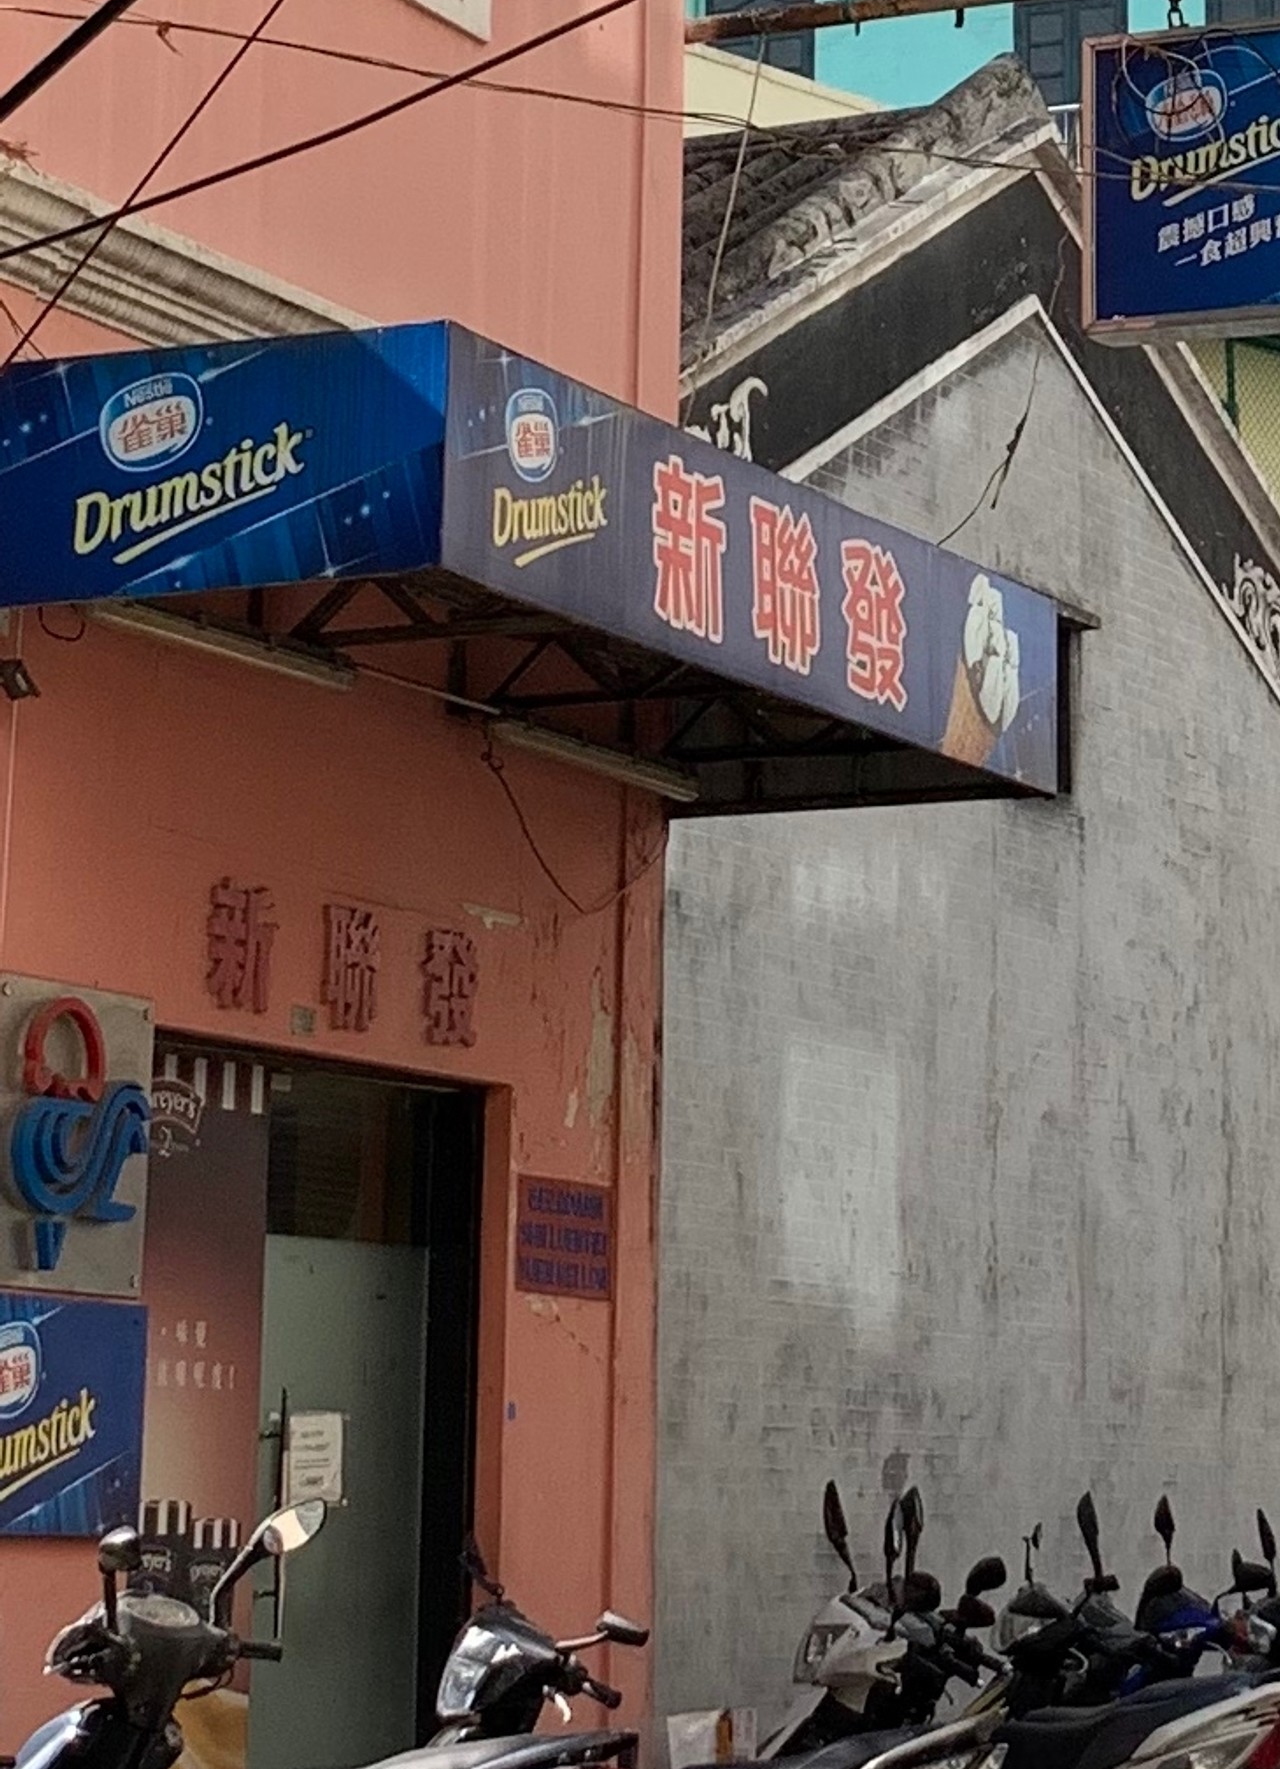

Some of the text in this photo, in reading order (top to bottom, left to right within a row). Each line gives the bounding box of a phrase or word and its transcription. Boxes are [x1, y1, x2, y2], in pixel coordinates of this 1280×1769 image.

[117, 400, 189, 455] 雀巢
[74, 421, 305, 556] Drumstick
[492, 474, 608, 548] Drumstick
[652, 454, 907, 713] 新聯發
[205, 875, 480, 1049] 新聯發
[0, 1387, 96, 1477] umstick
